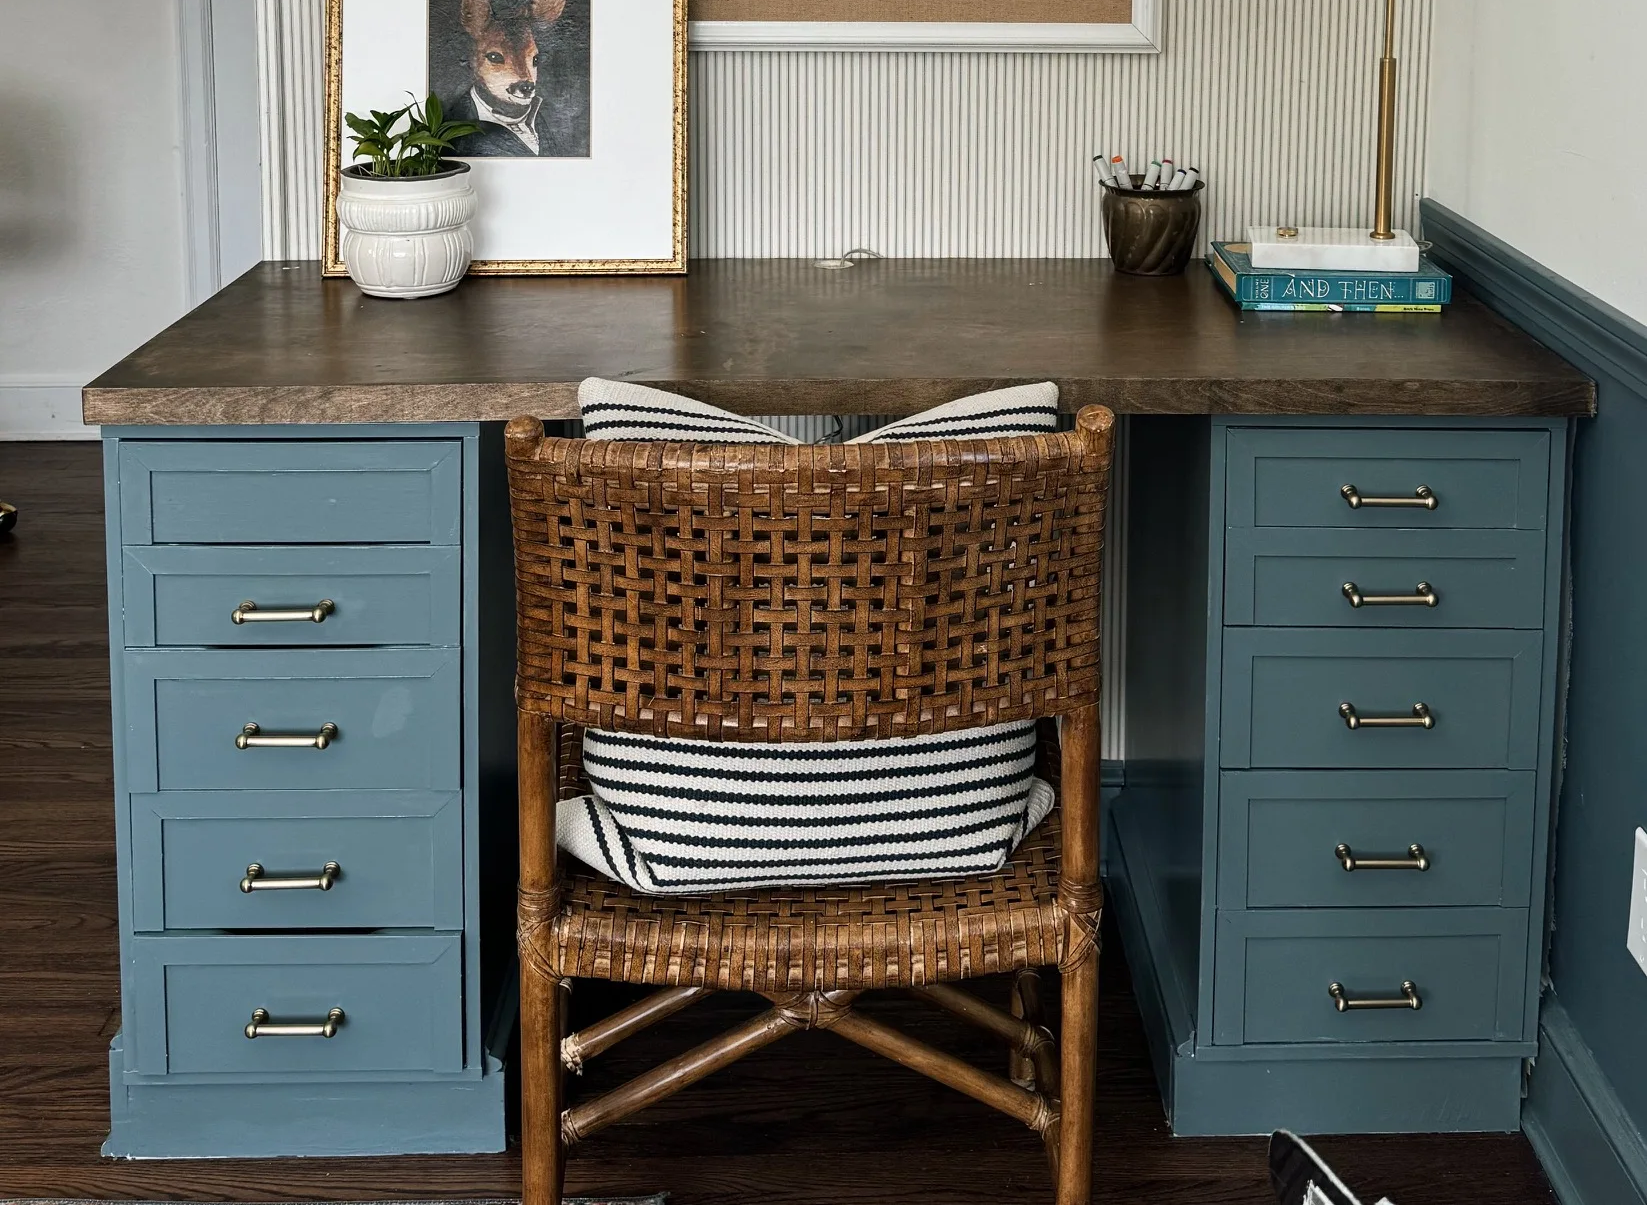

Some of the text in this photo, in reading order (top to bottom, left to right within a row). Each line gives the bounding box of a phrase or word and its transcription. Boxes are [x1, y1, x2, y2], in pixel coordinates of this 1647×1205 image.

[1260, 279, 1270, 299] ONE
[1281, 278, 1331, 299] AND
[1338, 280, 1404, 300] THEN...
